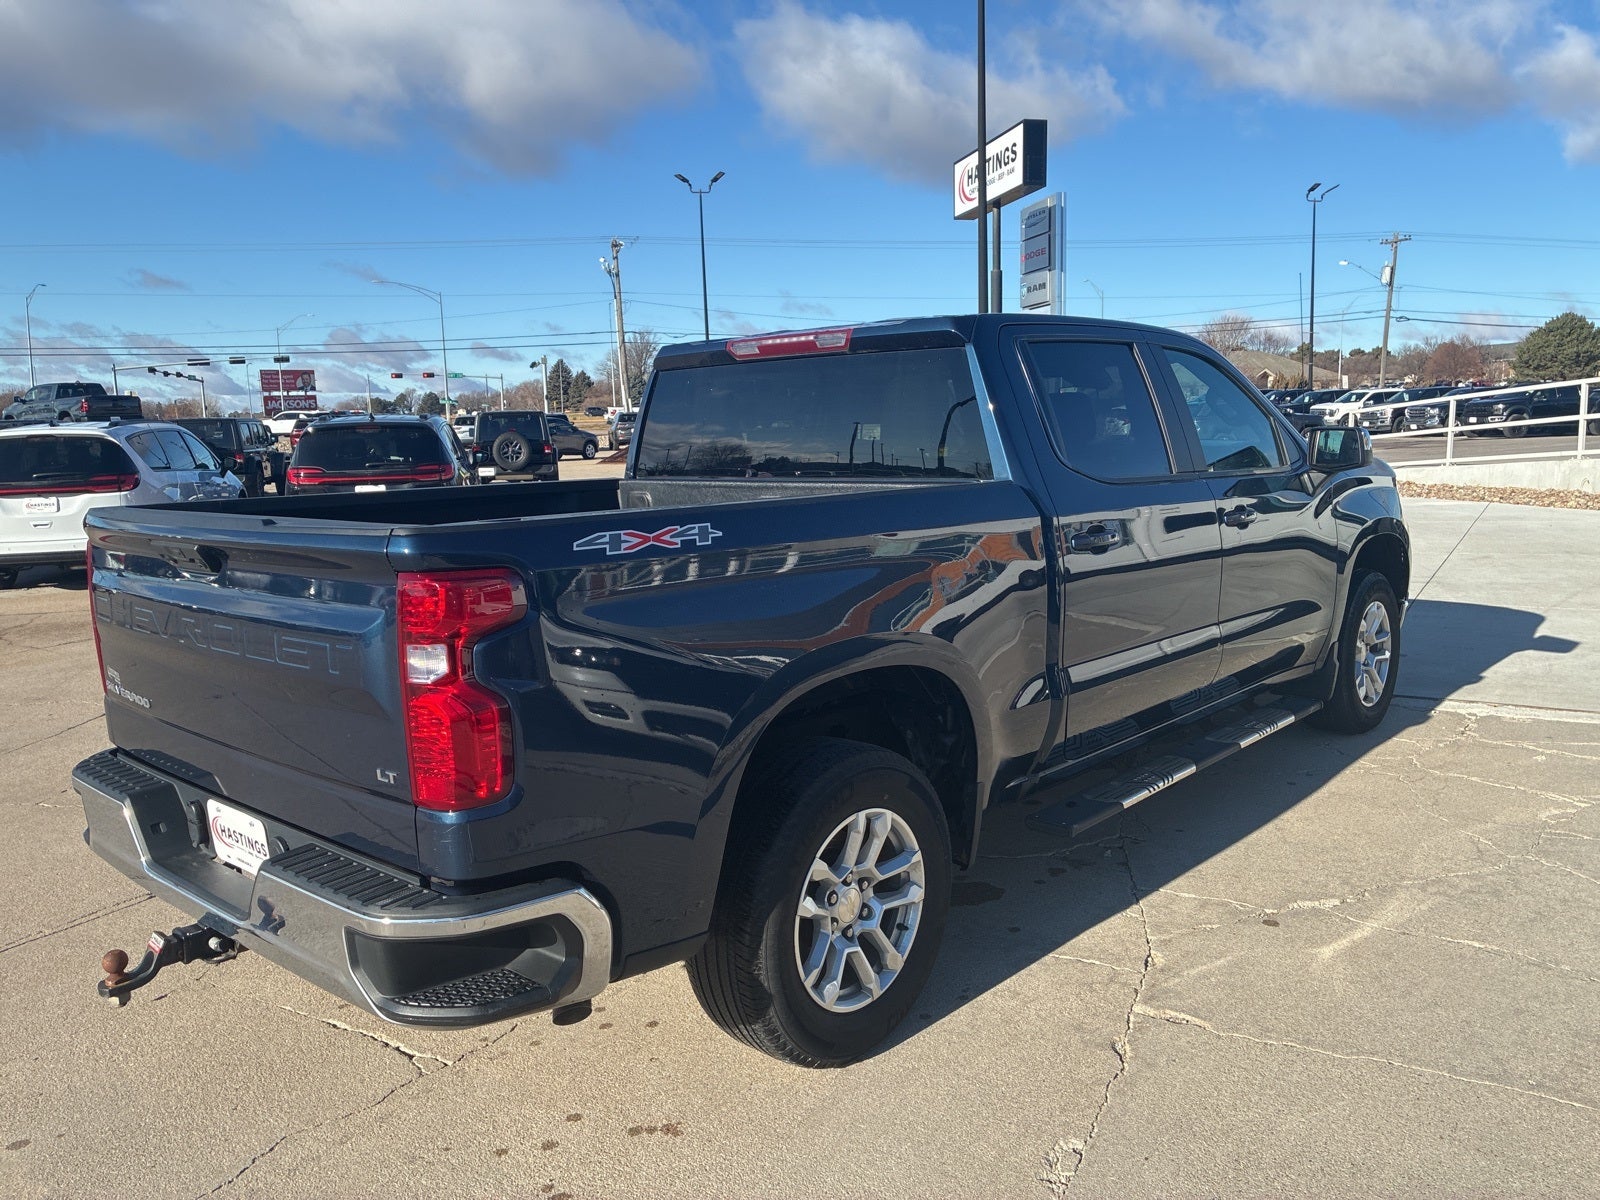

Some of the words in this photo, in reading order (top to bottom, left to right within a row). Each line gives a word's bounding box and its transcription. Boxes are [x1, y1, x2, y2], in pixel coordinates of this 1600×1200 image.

[967, 142, 1017, 187] HATINGS
[1021, 247, 1047, 262] DODGE
[1027, 282, 1046, 293] RAM
[266, 400, 316, 409] JACKSON'S
[95, 590, 353, 677] CHEVROLET
[106, 680, 152, 709] SILVERADO
[376, 768, 397, 785] LT
[219, 823, 268, 858] HASTINGS
